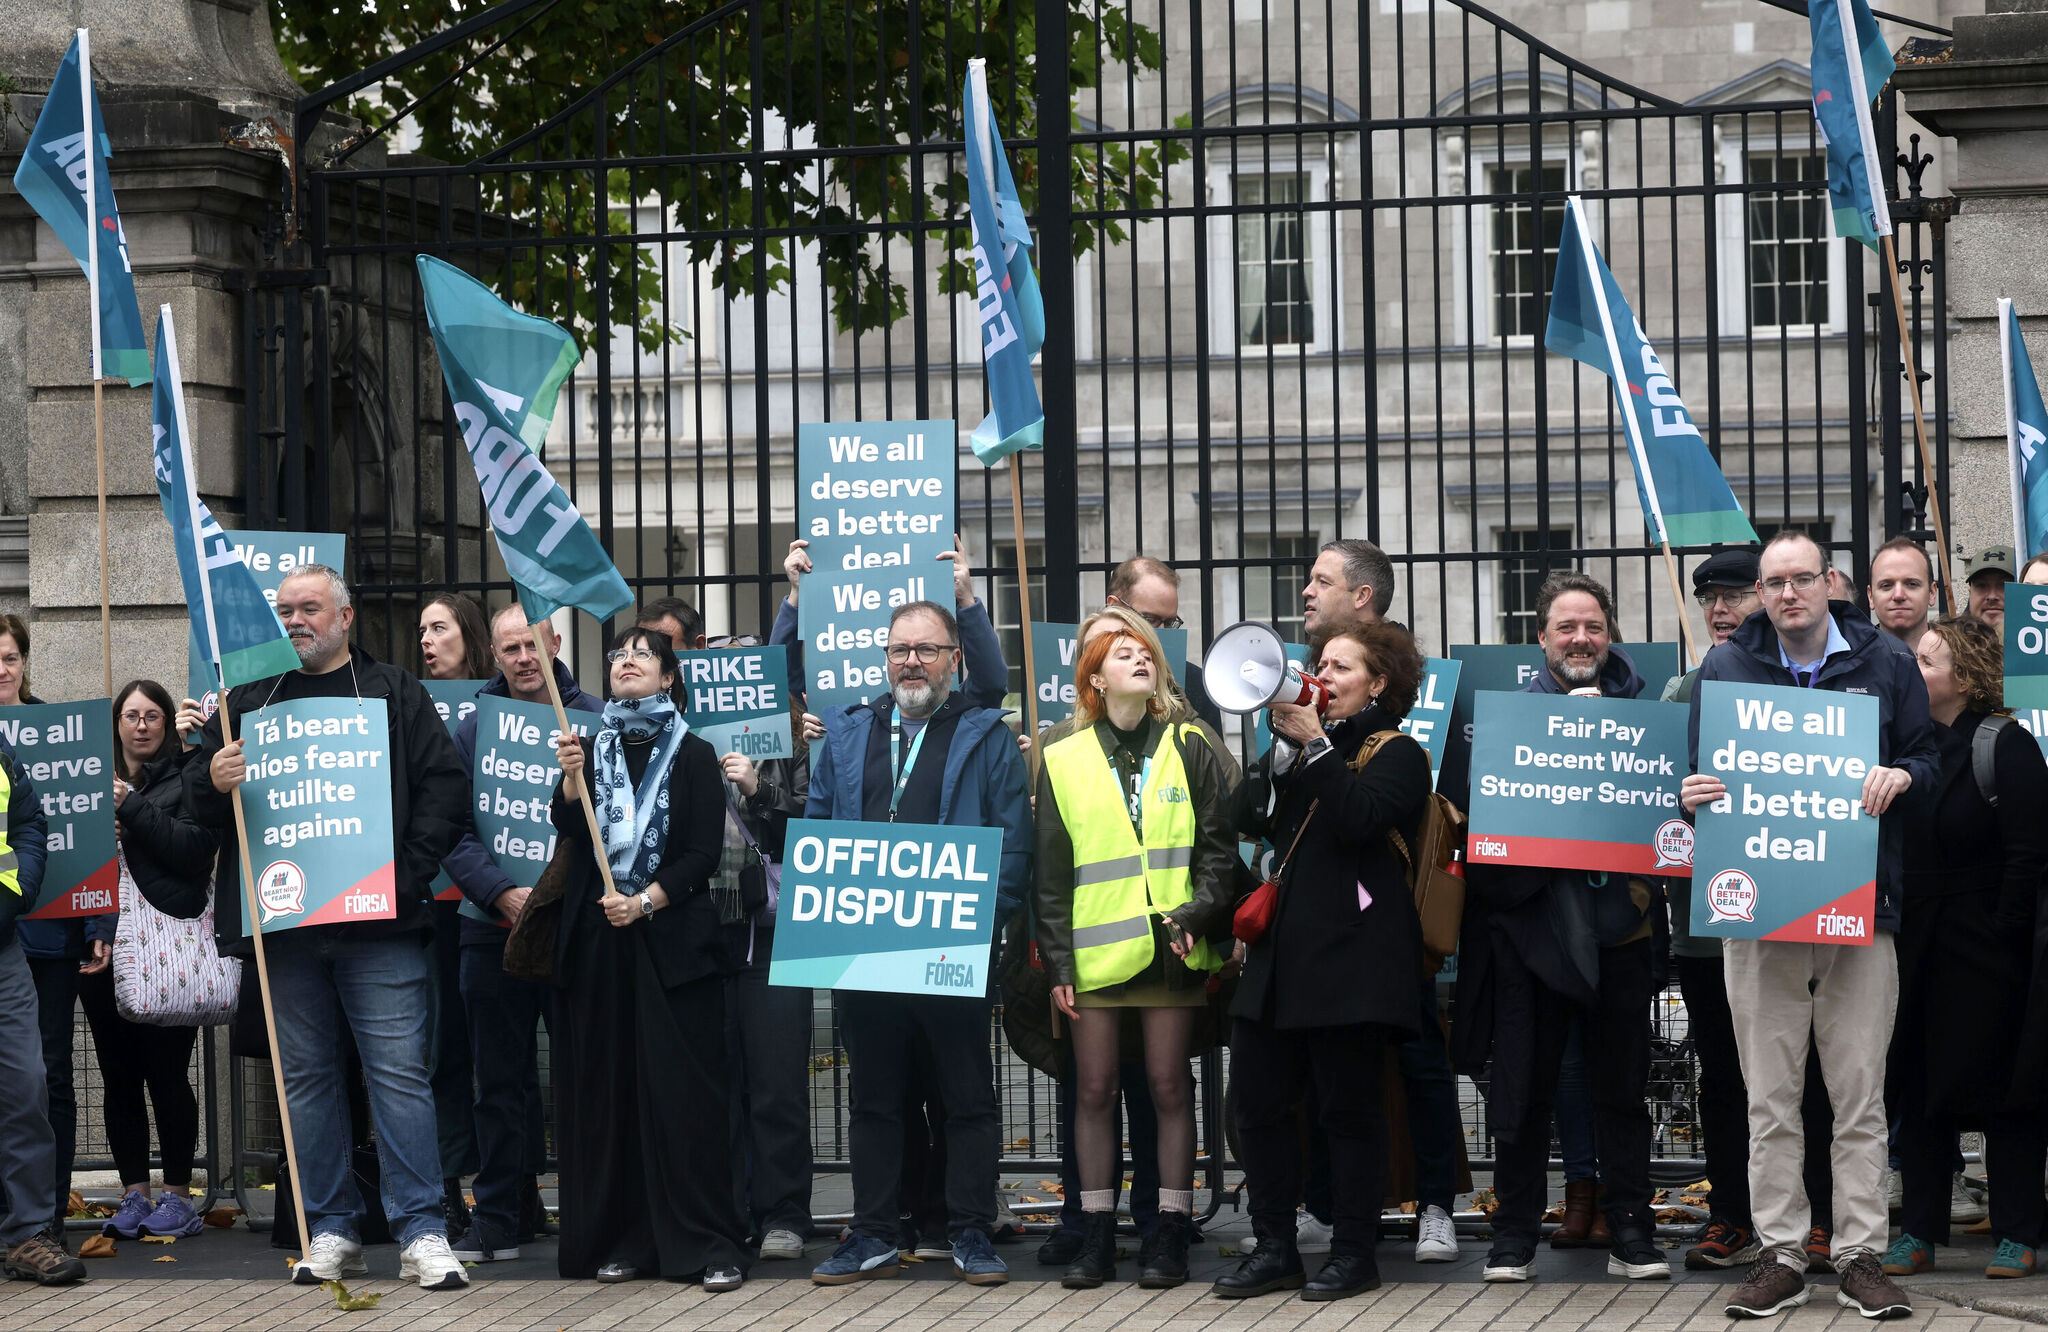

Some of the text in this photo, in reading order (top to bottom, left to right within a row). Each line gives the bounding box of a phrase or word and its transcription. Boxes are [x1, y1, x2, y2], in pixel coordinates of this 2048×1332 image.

[828, 433, 924, 463] We all
[810, 472, 943, 500] deserve
[810, 508, 943, 537] a better
[278, 545, 315, 572] all
[842, 543, 911, 571] deal
[832, 576, 925, 613] We all
[816, 623, 890, 653] dese
[679, 655, 764, 684] TRIKE
[817, 669, 836, 690] a
[694, 684, 778, 713] HERE
[47, 714, 84, 744] all
[254, 713, 369, 746] Tá beart
[498, 711, 541, 746] We
[1548, 715, 1646, 746] Fair Pay
[1735, 698, 1846, 737] We all
[731, 725, 783, 756] FÓRSA
[245, 744, 383, 782] níos fearr
[481, 748, 563, 786] deser
[1514, 745, 1674, 777] Decent Work
[1712, 739, 1866, 779] deserve
[40, 791, 104, 817] tter
[267, 778, 356, 811] tuillte
[478, 792, 490, 813] a
[1480, 775, 1679, 808] Stronger Servic
[1710, 782, 1866, 822] a better
[263, 812, 363, 848] againn
[493, 826, 556, 863] deal
[1662, 838, 1692, 847] BETTER
[1744, 827, 1827, 862] deal
[793, 836, 989, 882] OFFICIAL
[1475, 836, 1508, 857] FÓRSA
[72, 885, 113, 911] FÓRSA
[264, 889, 283, 897] BEART
[271, 893, 291, 902] FEARR
[344, 888, 389, 915] FÓRSA
[792, 884, 979, 930] DISPUTE
[1716, 890, 1752, 899] BETTER
[1716, 898, 1740, 906] DEAL
[1816, 907, 1865, 938] FÓRSA
[924, 954, 974, 988] FÓRSA
